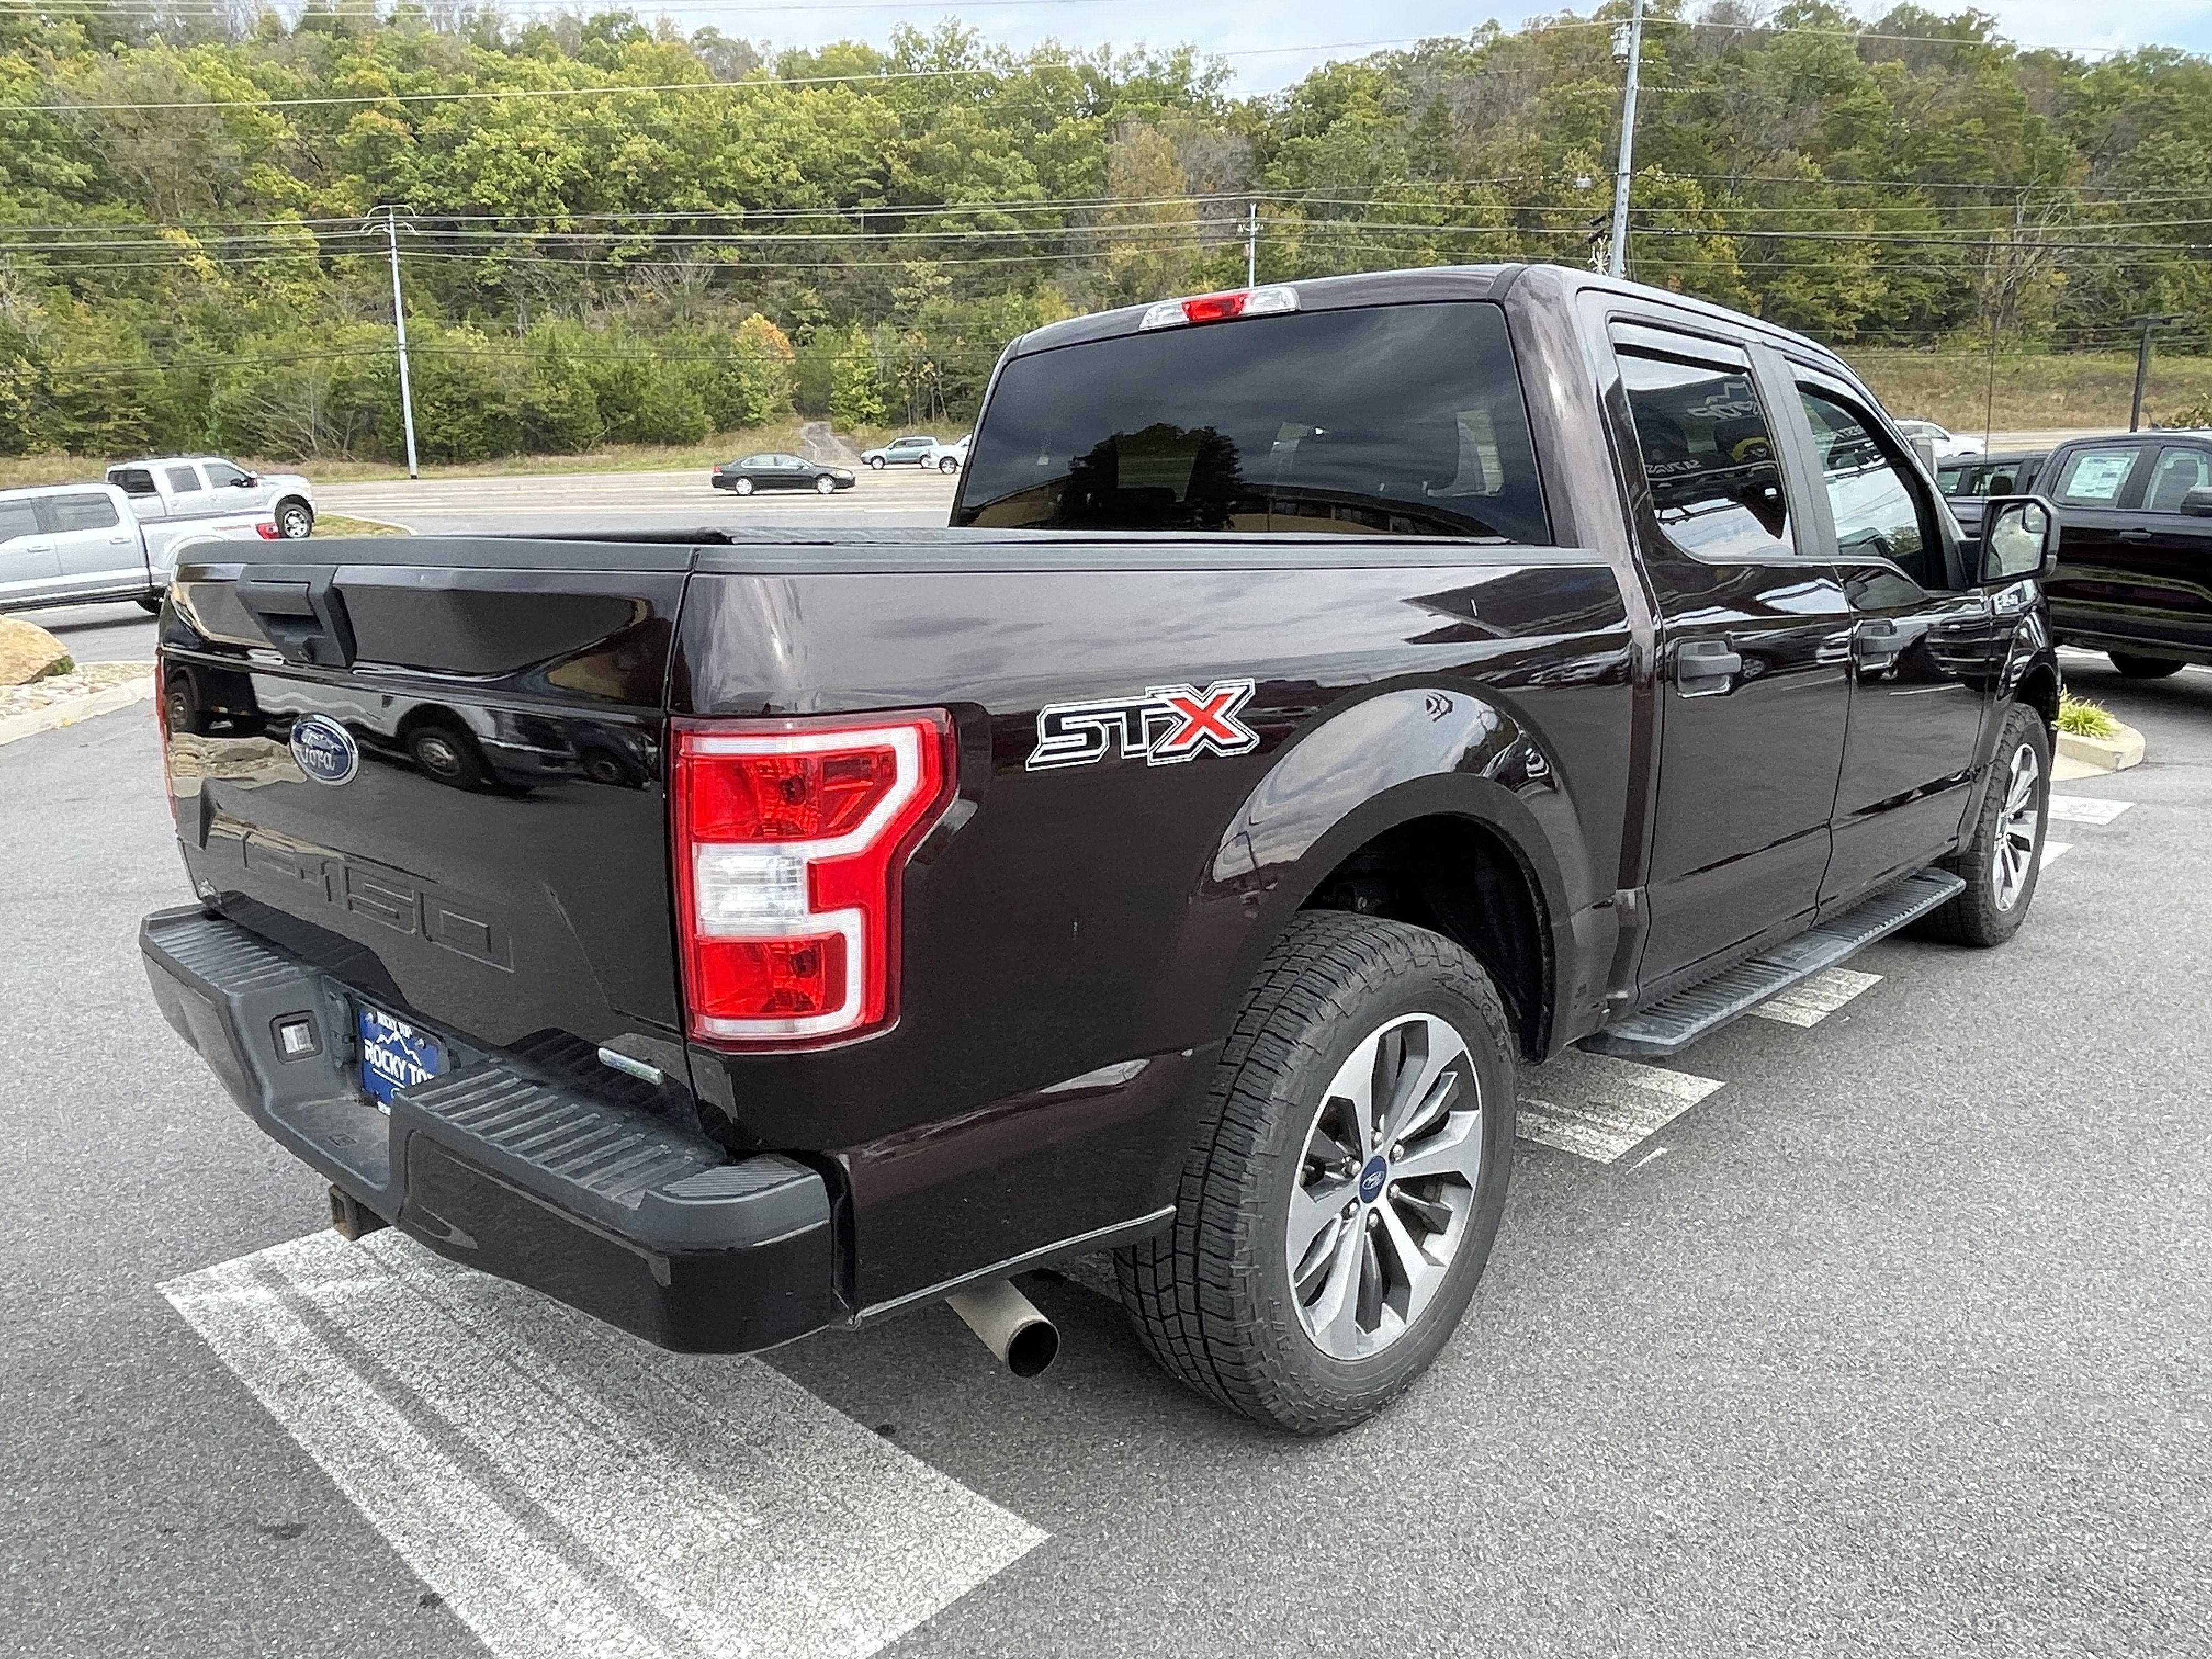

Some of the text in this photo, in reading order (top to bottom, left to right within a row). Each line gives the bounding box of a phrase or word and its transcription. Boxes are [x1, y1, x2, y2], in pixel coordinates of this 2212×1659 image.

[1025, 678, 1260, 771] STX
[242, 831, 514, 973] F-150
[364, 1038, 435, 1086] ROCKY TO
